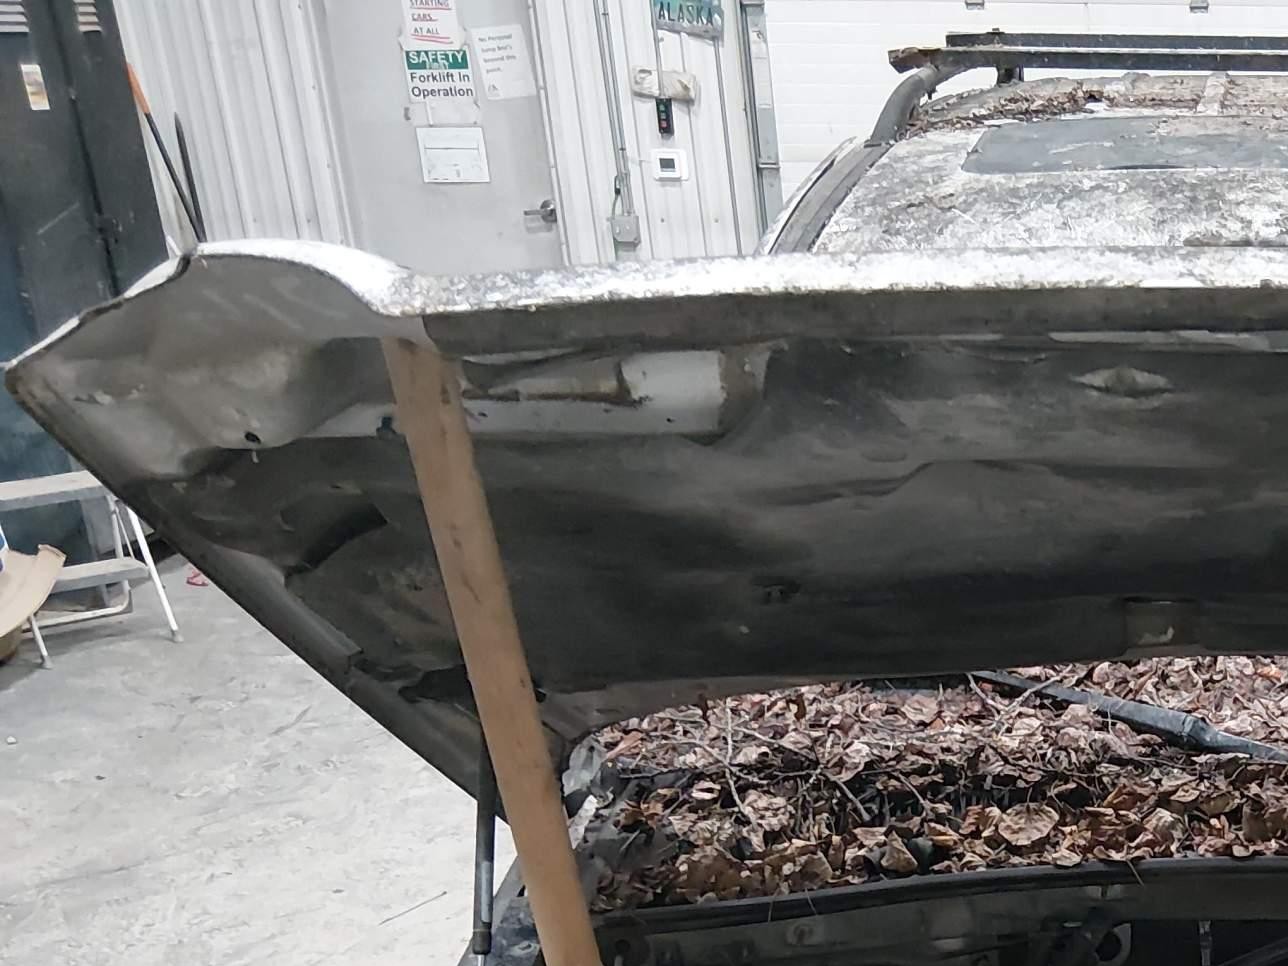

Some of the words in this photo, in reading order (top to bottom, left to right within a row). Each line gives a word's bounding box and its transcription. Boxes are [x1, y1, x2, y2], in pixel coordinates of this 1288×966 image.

[658, 1, 714, 26] ALASKA
[426, 27, 440, 35] ALL
[409, 51, 464, 64] SAFETY
[410, 72, 455, 83] Forklift
[459, 73, 470, 82] In
[411, 86, 474, 99] Operation
